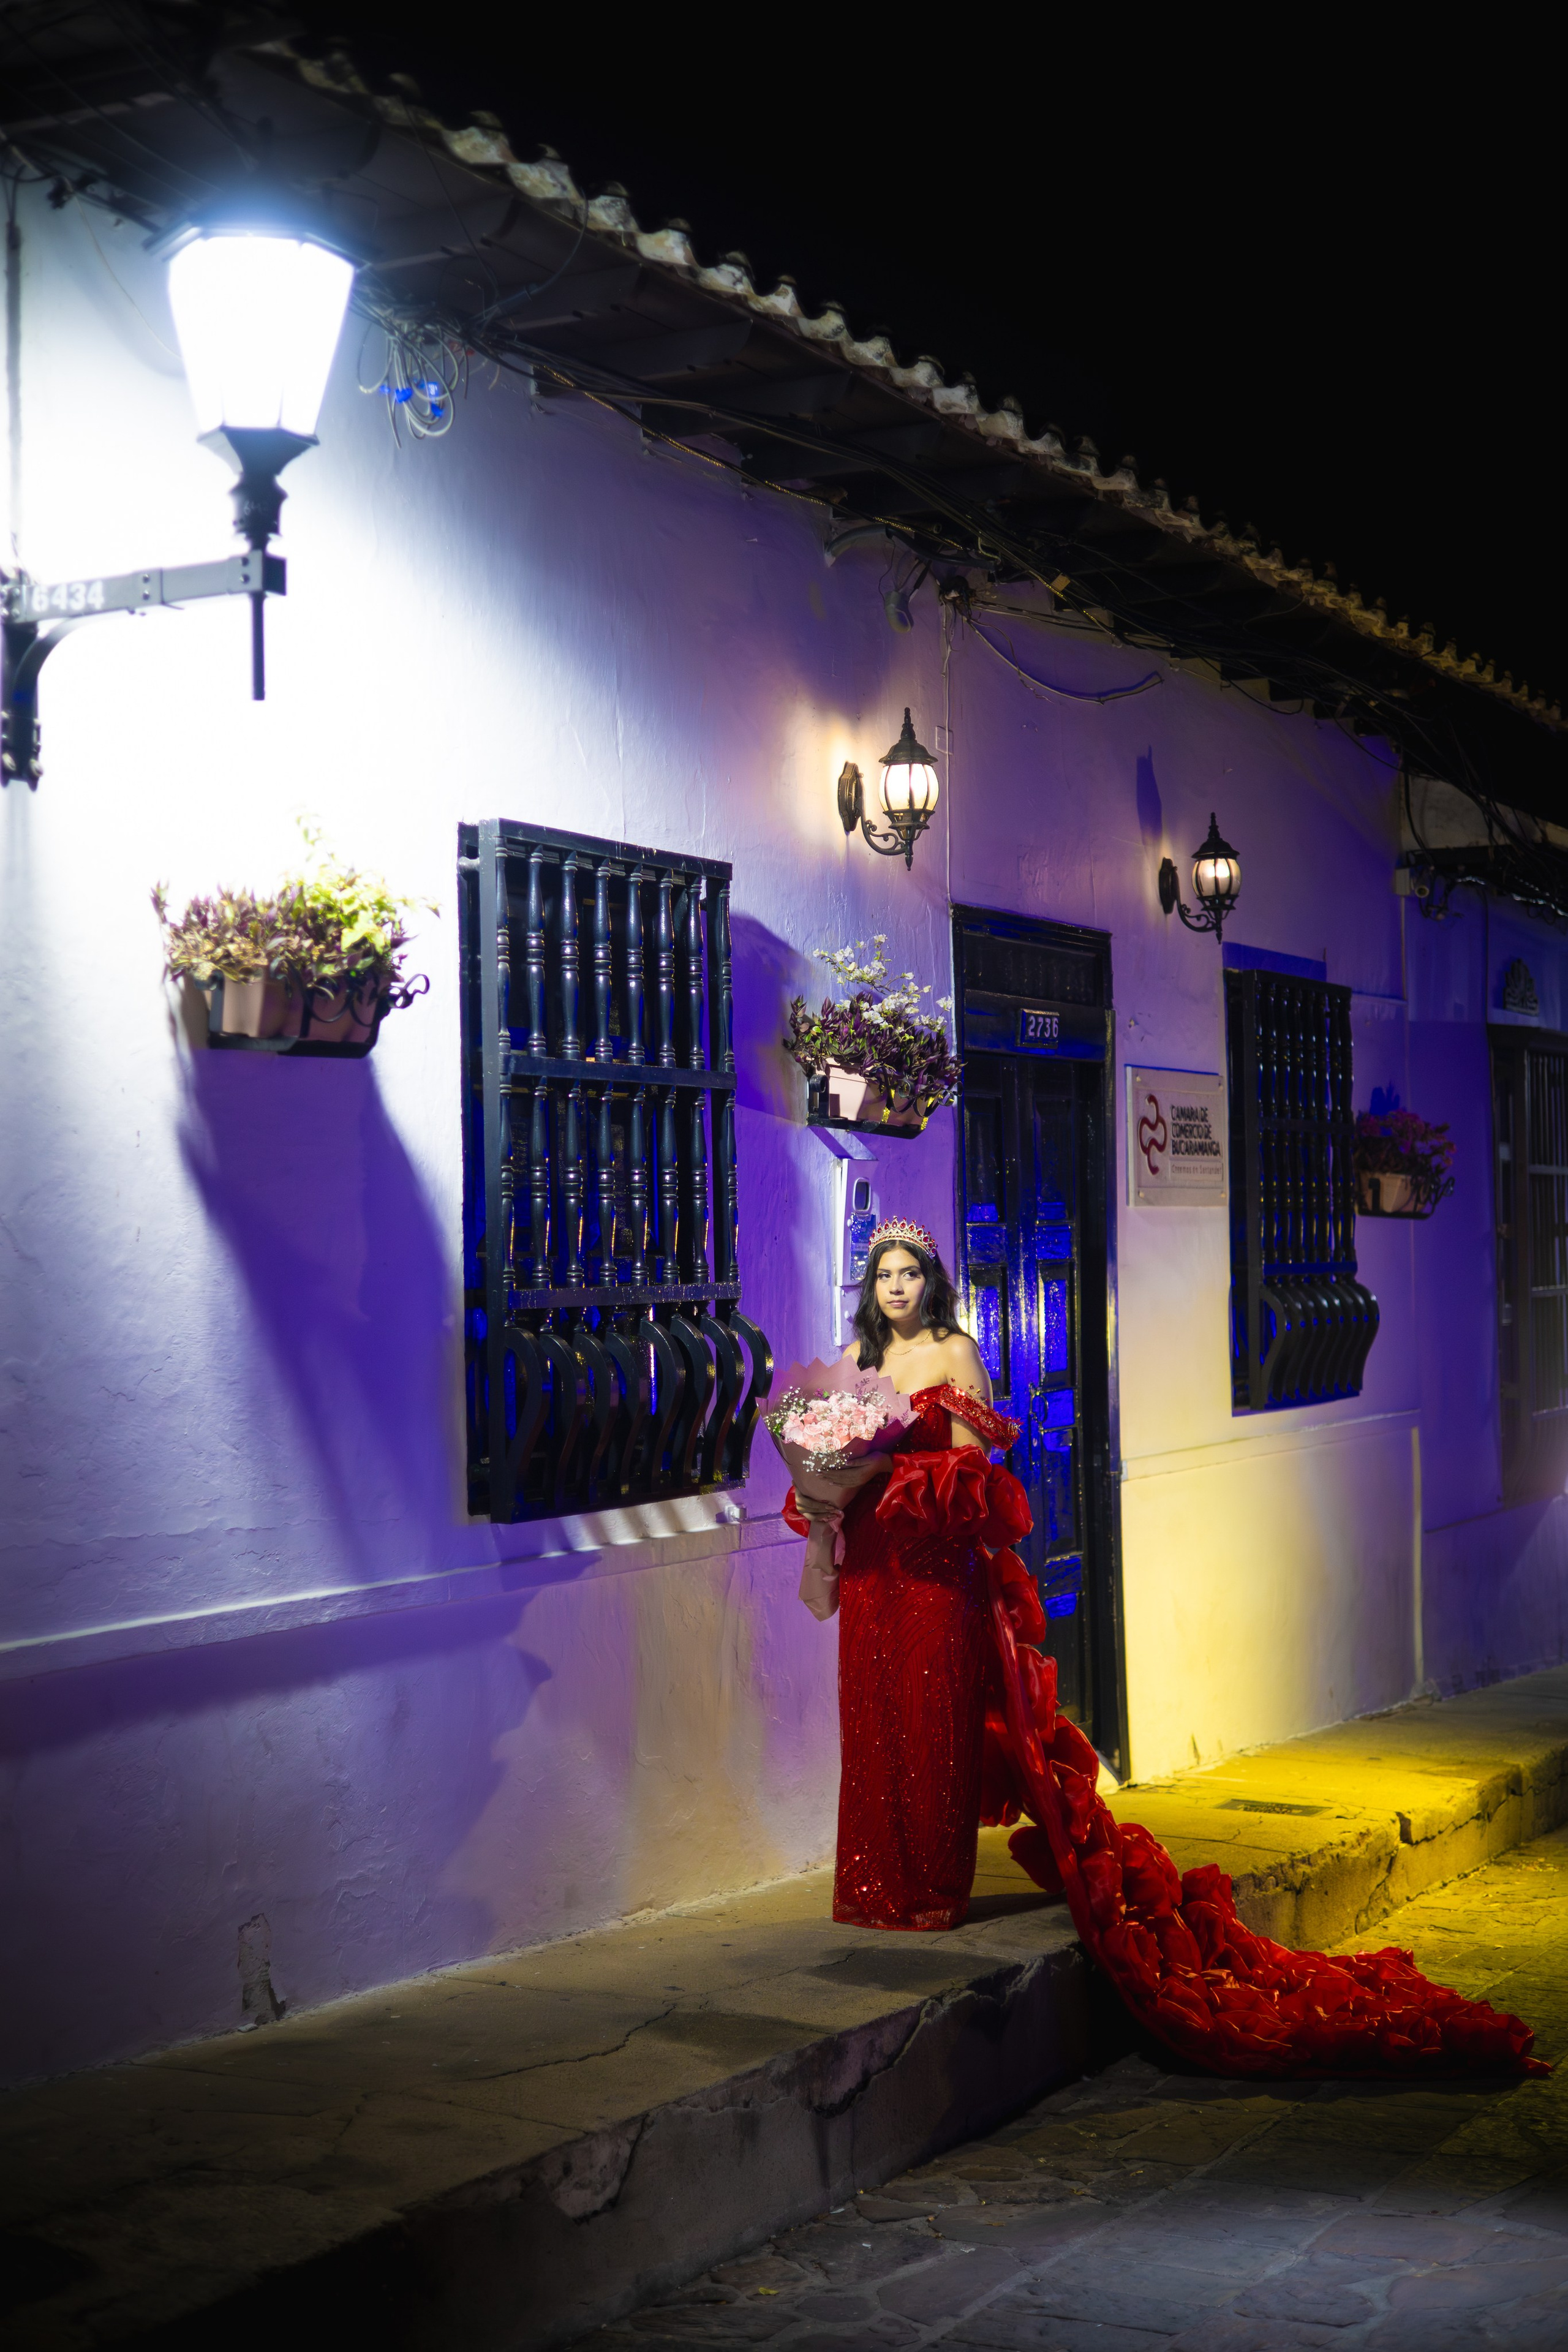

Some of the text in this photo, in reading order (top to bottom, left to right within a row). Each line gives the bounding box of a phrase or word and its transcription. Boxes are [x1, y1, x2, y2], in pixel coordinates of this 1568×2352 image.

[32, 581, 104, 611] 6434
[1028, 1016, 1058, 1038] 2736
[1200, 1107, 1208, 1122] DE
[1172, 1123, 1212, 1139] COMERCIO DE
[1172, 1140, 1221, 1156] BUCARAMANGA
